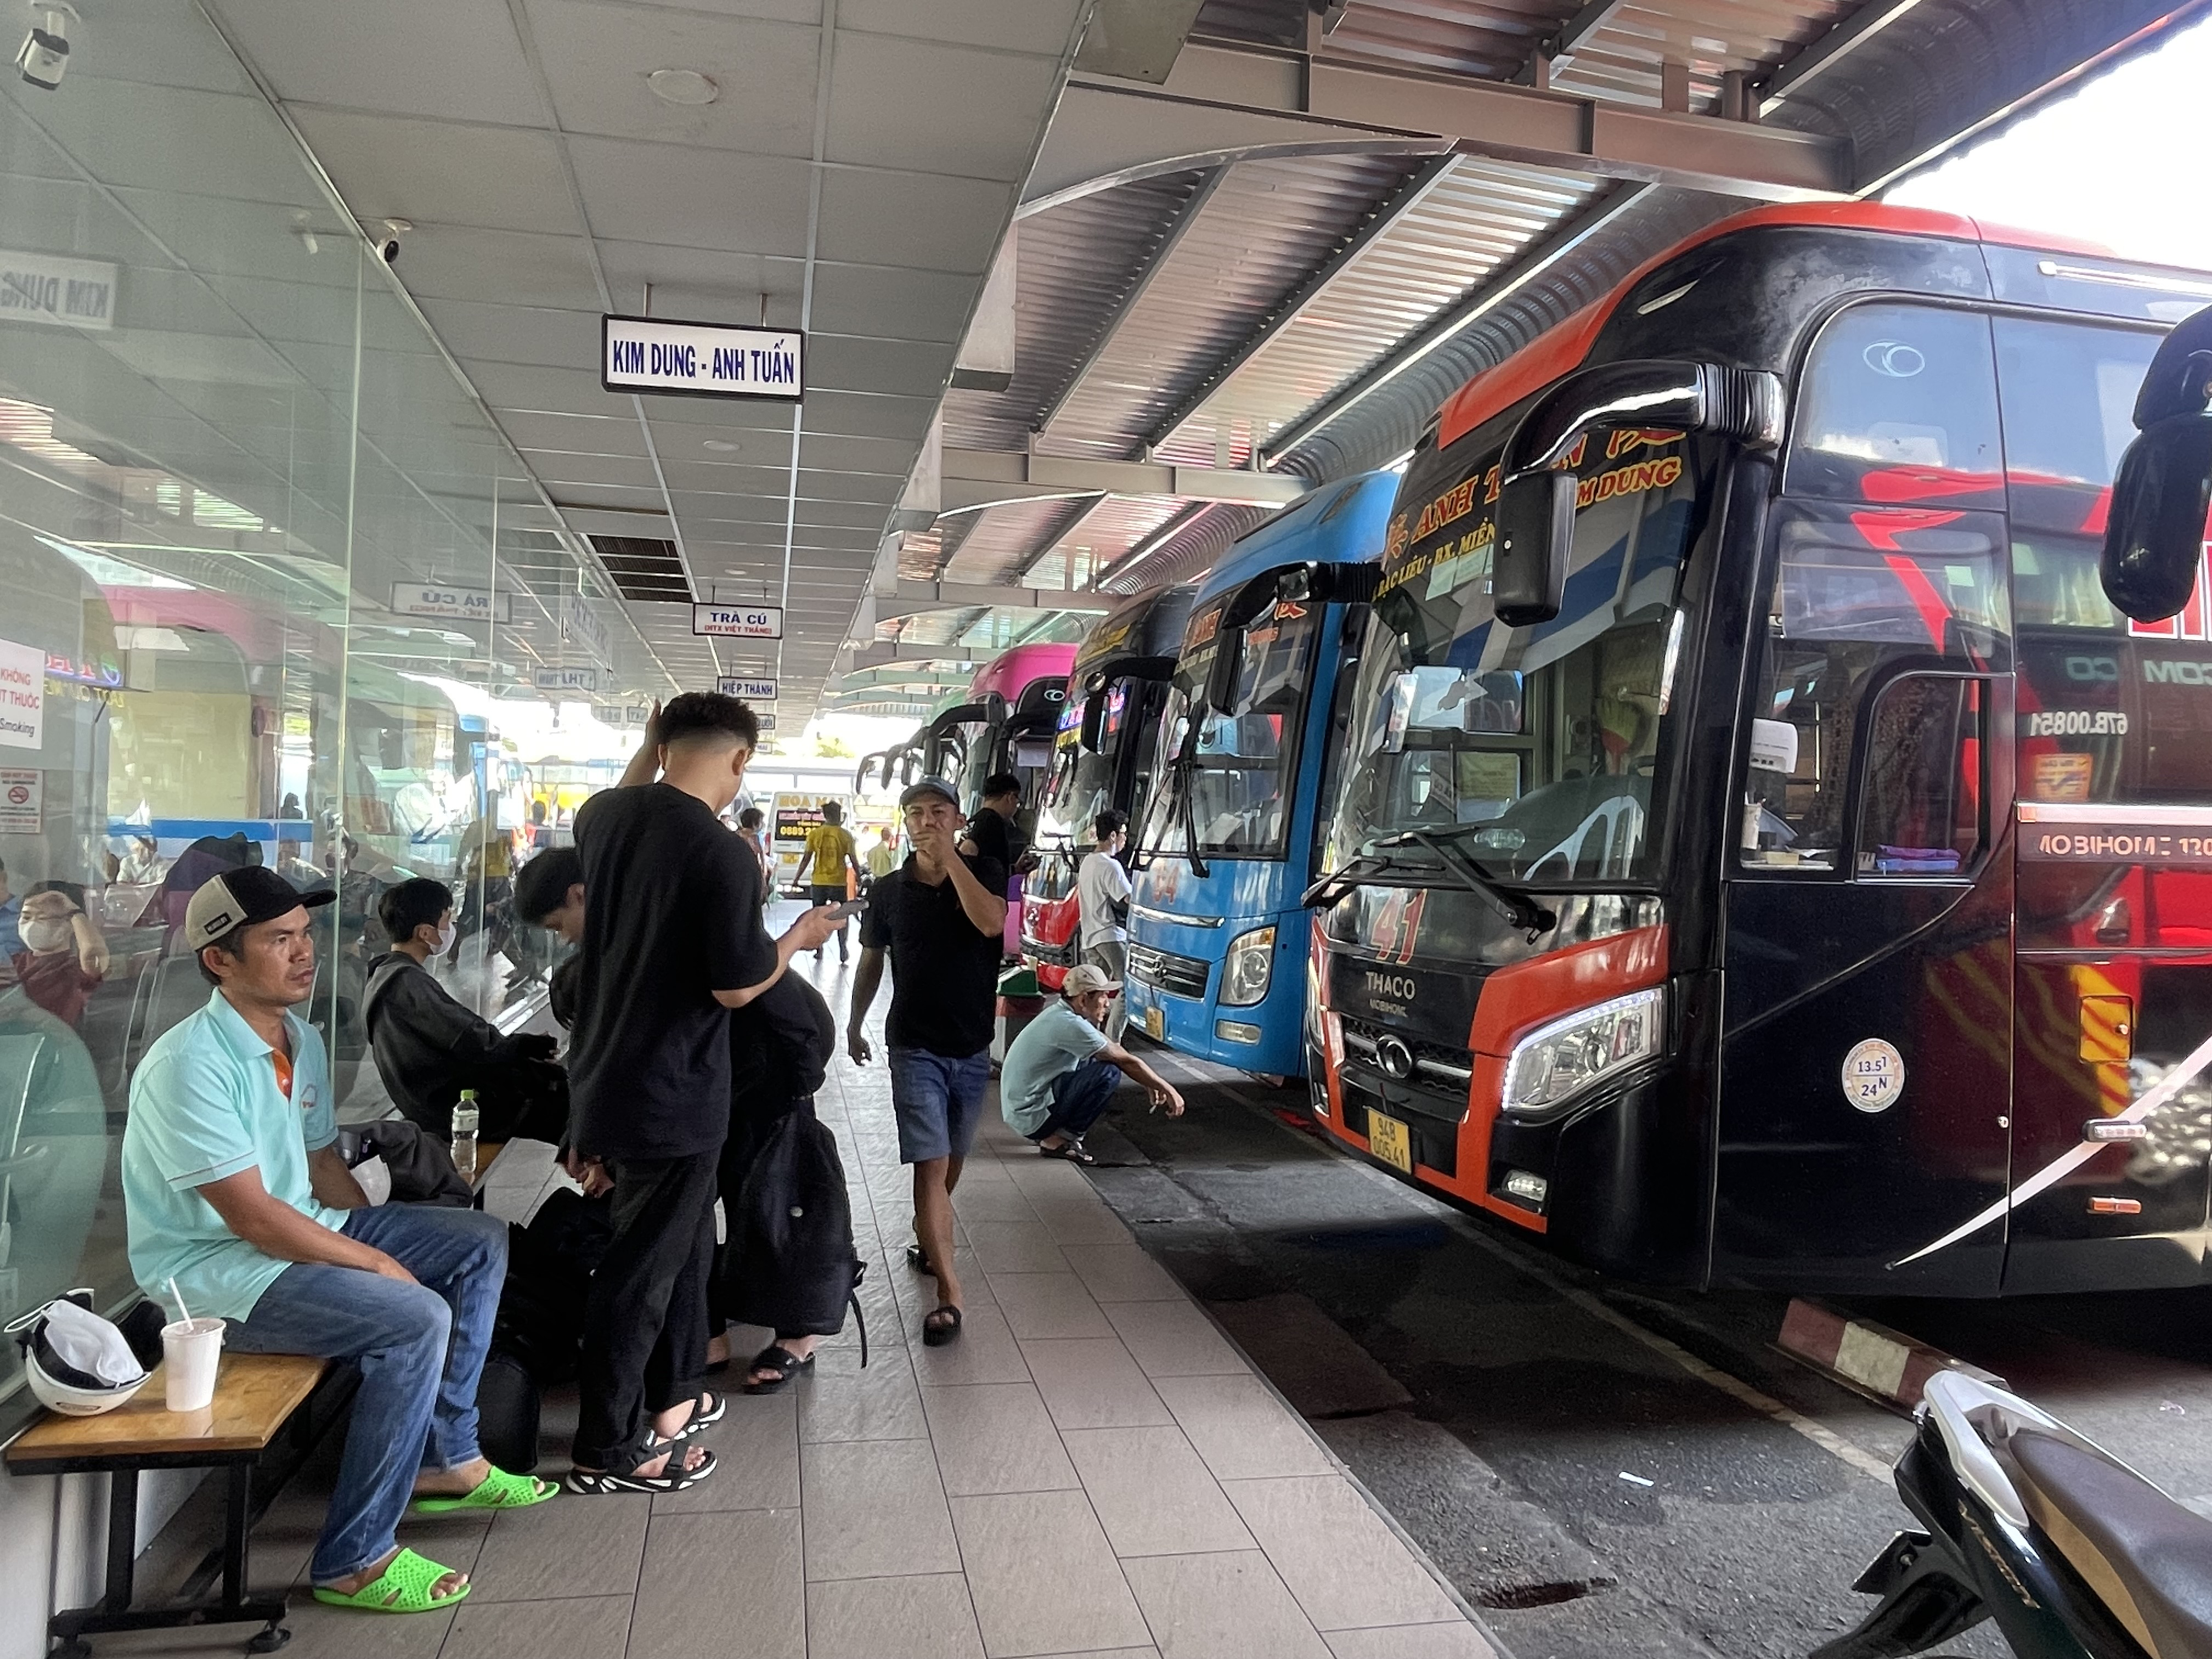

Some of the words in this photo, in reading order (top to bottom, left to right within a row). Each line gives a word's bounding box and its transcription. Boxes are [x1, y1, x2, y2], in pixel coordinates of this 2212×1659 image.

[613, 340, 645, 375] KIM
[651, 342, 696, 379] DUNG
[712, 347, 746, 381] ANH
[751, 338, 794, 385] TUẤN
[1594, 455, 1683, 503] DUNG
[1409, 474, 1480, 546] ANH
[710, 610, 741, 623] TRÀ
[747, 612, 767, 625] CÚ
[1, 667, 31, 686] KHÔNG
[722, 680, 743, 696] HIỆP
[9, 690, 40, 710] THUỐC
[0, 718, 35, 737] Smoking
[1370, 888, 1427, 966] 41
[1365, 970, 1416, 1000] THACO
